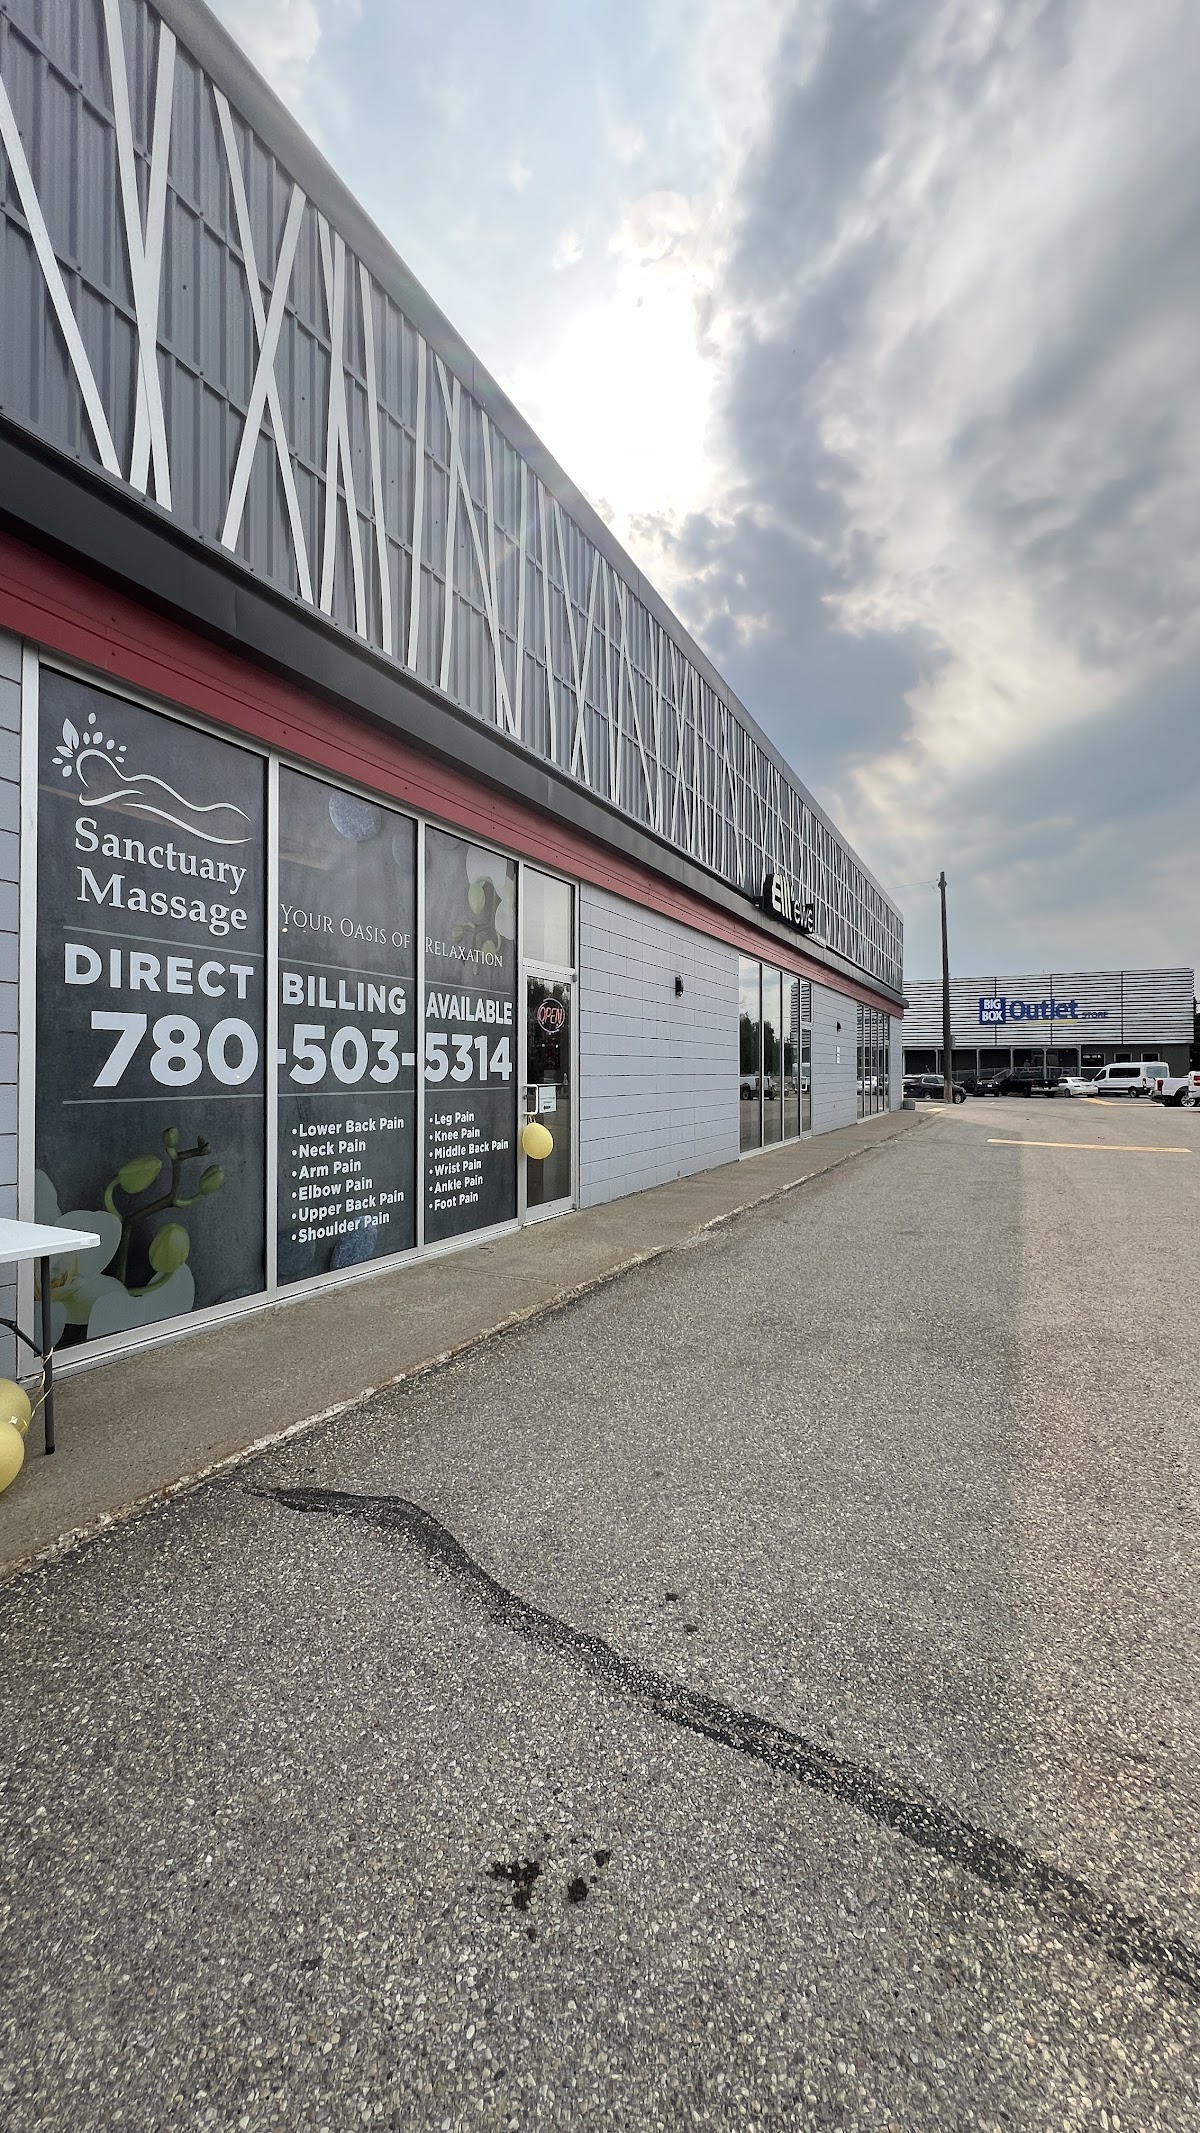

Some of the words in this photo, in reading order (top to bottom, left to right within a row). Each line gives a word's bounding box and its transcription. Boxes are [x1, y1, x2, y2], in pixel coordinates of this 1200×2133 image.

[75, 817, 247, 895] Sanctuary
[77, 866, 248, 936] Massage
[280, 903, 334, 934] YOUR
[340, 918, 387, 945] OASIS
[425, 936, 503, 967] RELAXATION
[64, 942, 254, 1000] DIRECT
[282, 972, 406, 1015] BILLING
[426, 991, 513, 1025] AVAILABLE
[984, 999, 1001, 1010] BIG
[1010, 998, 1078, 1020] Outlet
[540, 1006, 562, 1025] OPEN
[982, 1010, 1003, 1021] BOX
[299, 1121, 341, 1137] Lower
[345, 1118, 376, 1133] Back
[379, 1116, 404, 1130] Pain
[434, 1113, 452, 1126] Leg
[455, 1110, 475, 1124] Pain
[434, 1130, 458, 1142] Knee
[461, 1127, 480, 1139] Pain
[299, 1141, 334, 1158] Neck
[339, 1138, 366, 1154] Pain
[434, 1144, 466, 1160] Middle
[469, 1141, 489, 1154] Back
[492, 1139, 509, 1151] Pain
[298, 1164, 329, 1180] Arm
[333, 1158, 361, 1174] Pain
[434, 1162, 460, 1176] Wrist
[463, 1159, 482, 1172] Pain
[298, 1182, 342, 1201] Elbow
[346, 1176, 373, 1192] Pain
[434, 1180, 462, 1194] Ankle
[464, 1175, 483, 1188] Pain
[298, 1203, 341, 1223] Upper
[345, 1197, 376, 1214] Back
[379, 1190, 404, 1206] Pain
[434, 1197, 456, 1211] Foot
[459, 1191, 479, 1206] Pain
[298, 1218, 361, 1243] Shoulder
[364, 1211, 390, 1228] Pain
